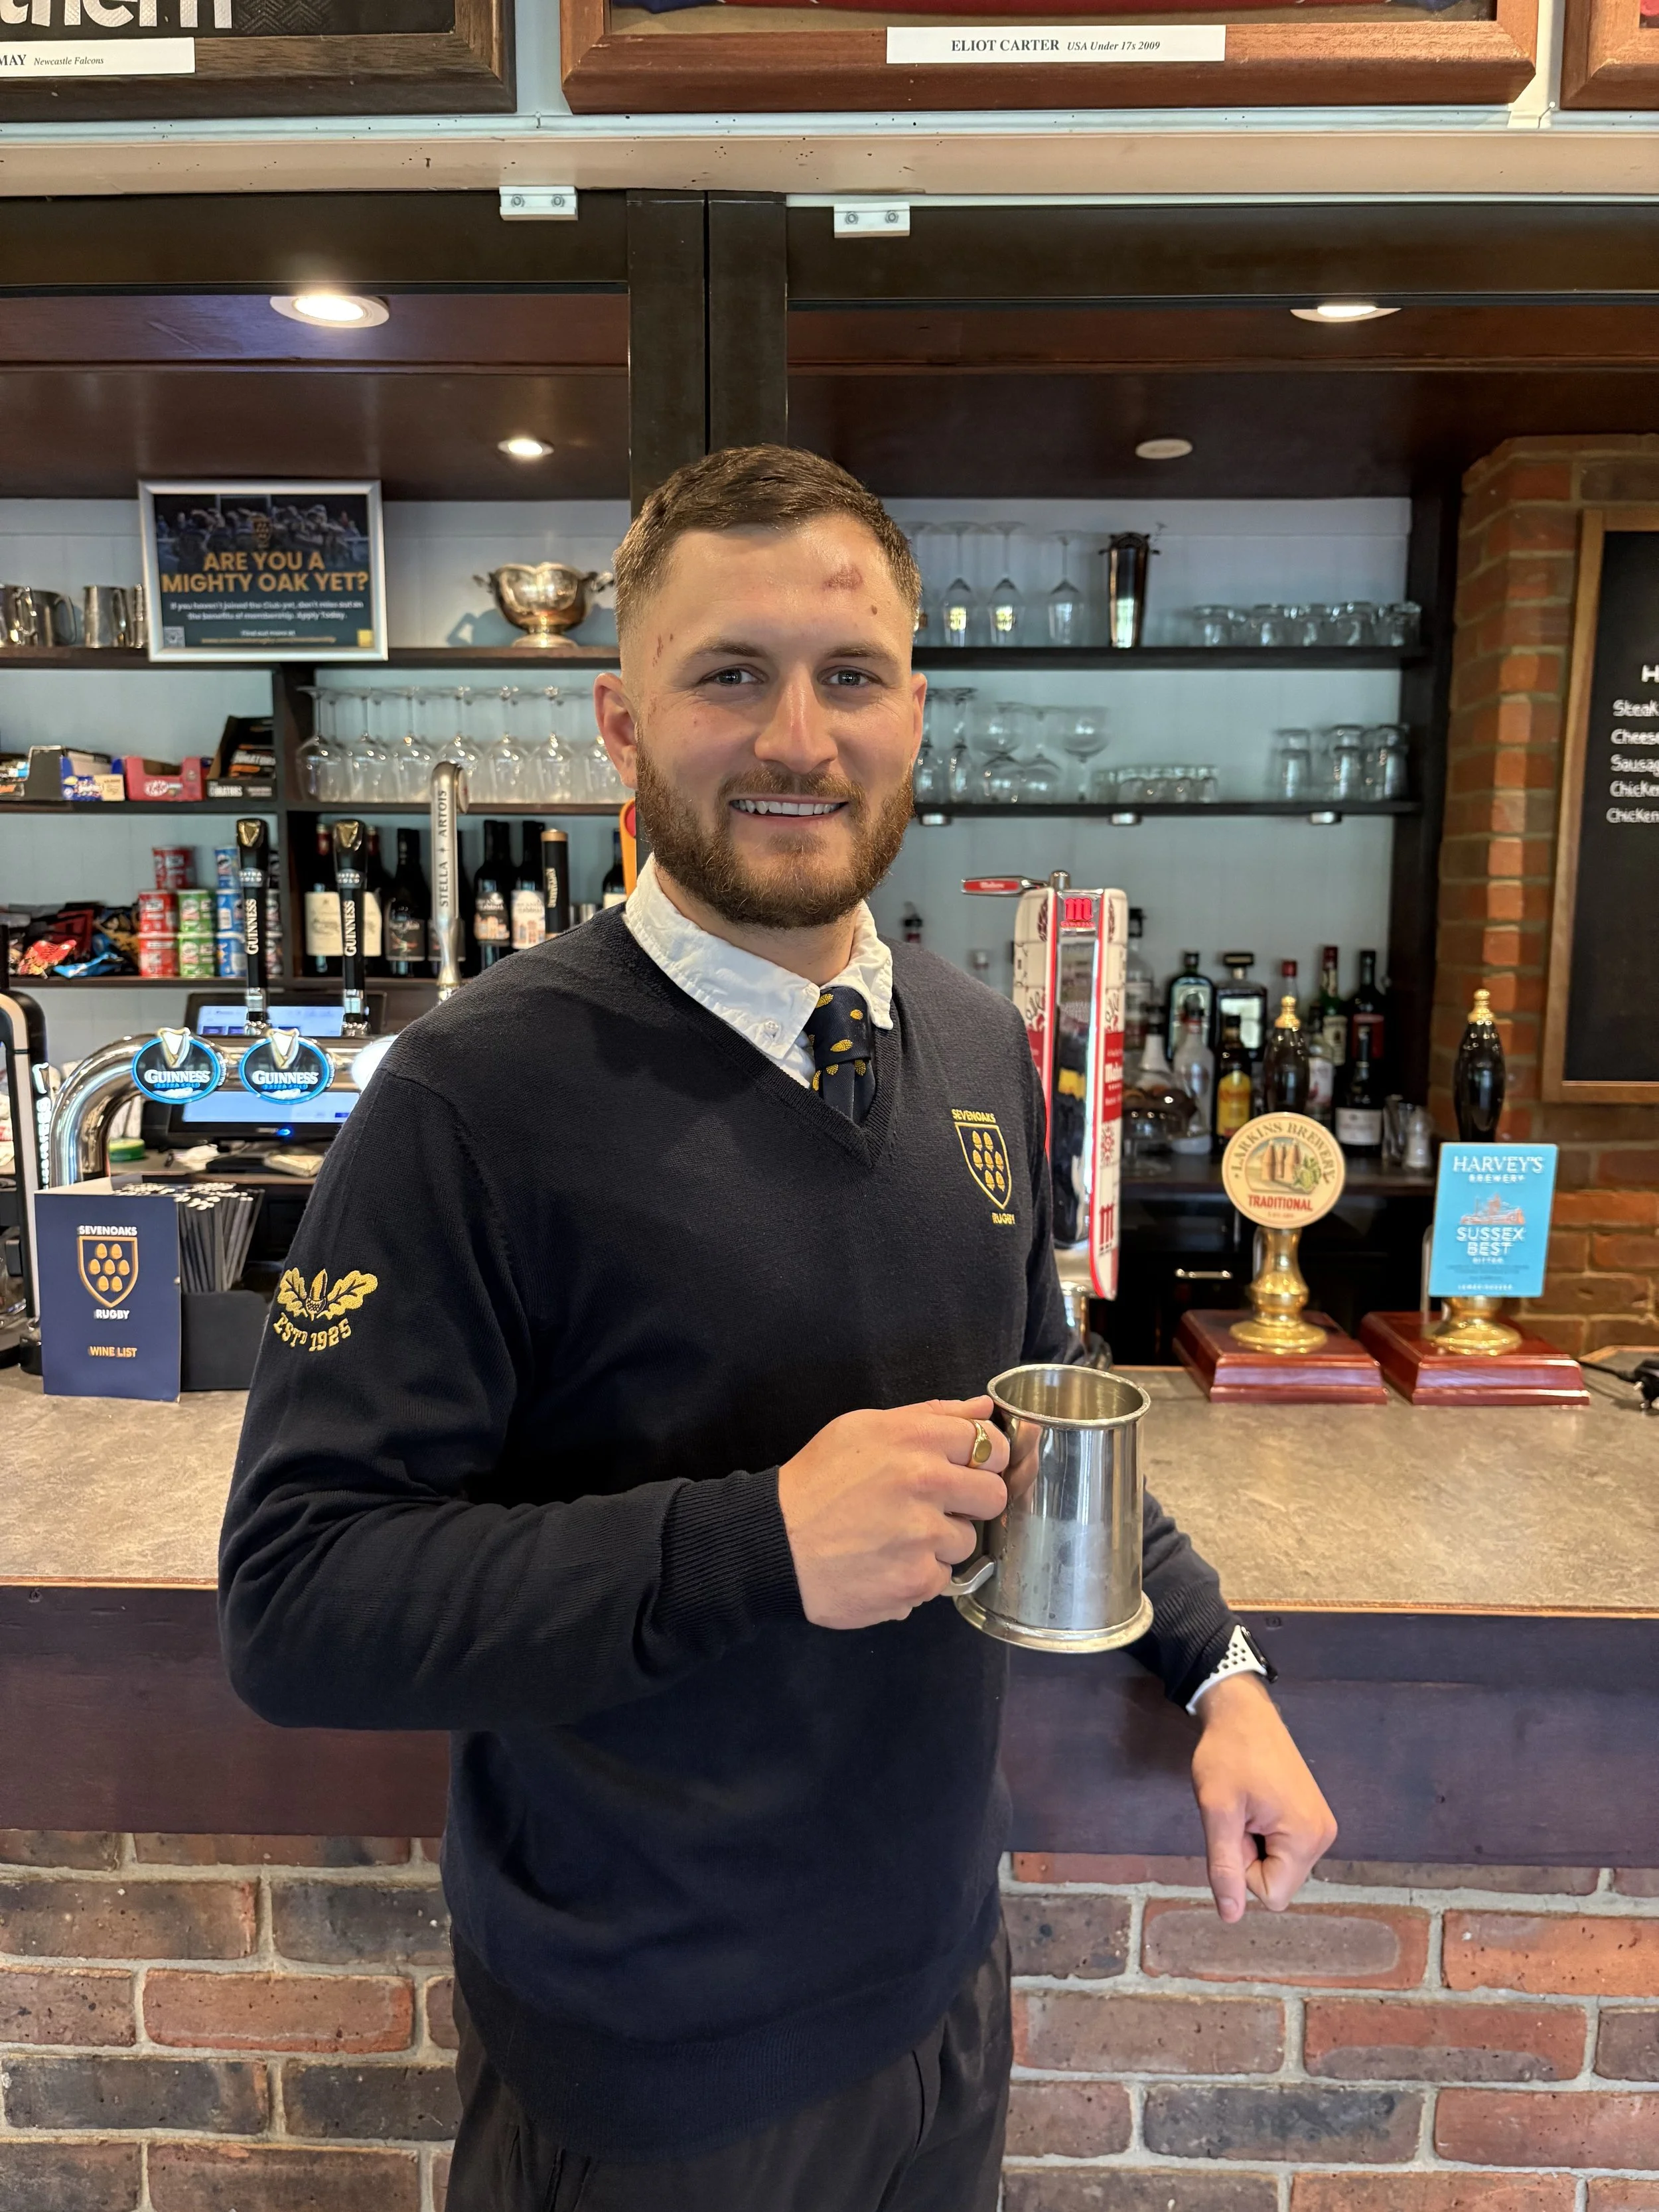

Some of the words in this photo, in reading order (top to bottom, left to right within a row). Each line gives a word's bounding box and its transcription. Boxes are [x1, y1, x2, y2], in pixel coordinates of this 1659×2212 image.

[951, 40, 996, 52] ELIOT
[1000, 39, 1060, 51] CARTER
[1067, 42, 1087, 51] USA
[1090, 41, 1119, 50] Under
[1121, 41, 1136, 50] 17s
[1138, 40, 1161, 50] 2009
[0, 54, 26, 66] MAY
[34, 57, 72, 66] Newcastle
[74, 56, 104, 65] Falcons
[202, 552, 248, 571] ARE
[252, 552, 303, 570] YOU
[308, 551, 326, 571] A
[161, 573, 253, 593] MIGHTY
[257, 573, 310, 592] OAK
[313, 571, 369, 591] YET?
[438, 790, 447, 838] ARTOIS
[439, 861, 449, 907] STELLA
[246, 899, 259, 955] GUINNESS
[343, 900, 357, 956] GUINNESS
[144, 1069, 211, 1084] GUINNESS
[252, 1070, 319, 1085] GUINNESS
[952, 1109, 996, 1123] SEVENOAKS
[1231, 1122, 1282, 1171] LARKINS
[1287, 1122, 1336, 1184] BREWERY
[1453, 1155, 1545, 1173] HARVEY'S
[1468, 1174, 1526, 1183] BREWERY
[1248, 1195, 1313, 1212] TRADITIONAL
[991, 1213, 1015, 1224] RUGBY
[78, 1225, 137, 1236] SEVENOAKS
[1456, 1226, 1526, 1242] SUSSEX
[1467, 1242, 1514, 1256] BEST
[94, 1309, 130, 1319] RUGBY
[309, 1317, 352, 1352] 1925
[88, 1346, 115, 1357] WINE
[116, 1347, 137, 1358] LIST
